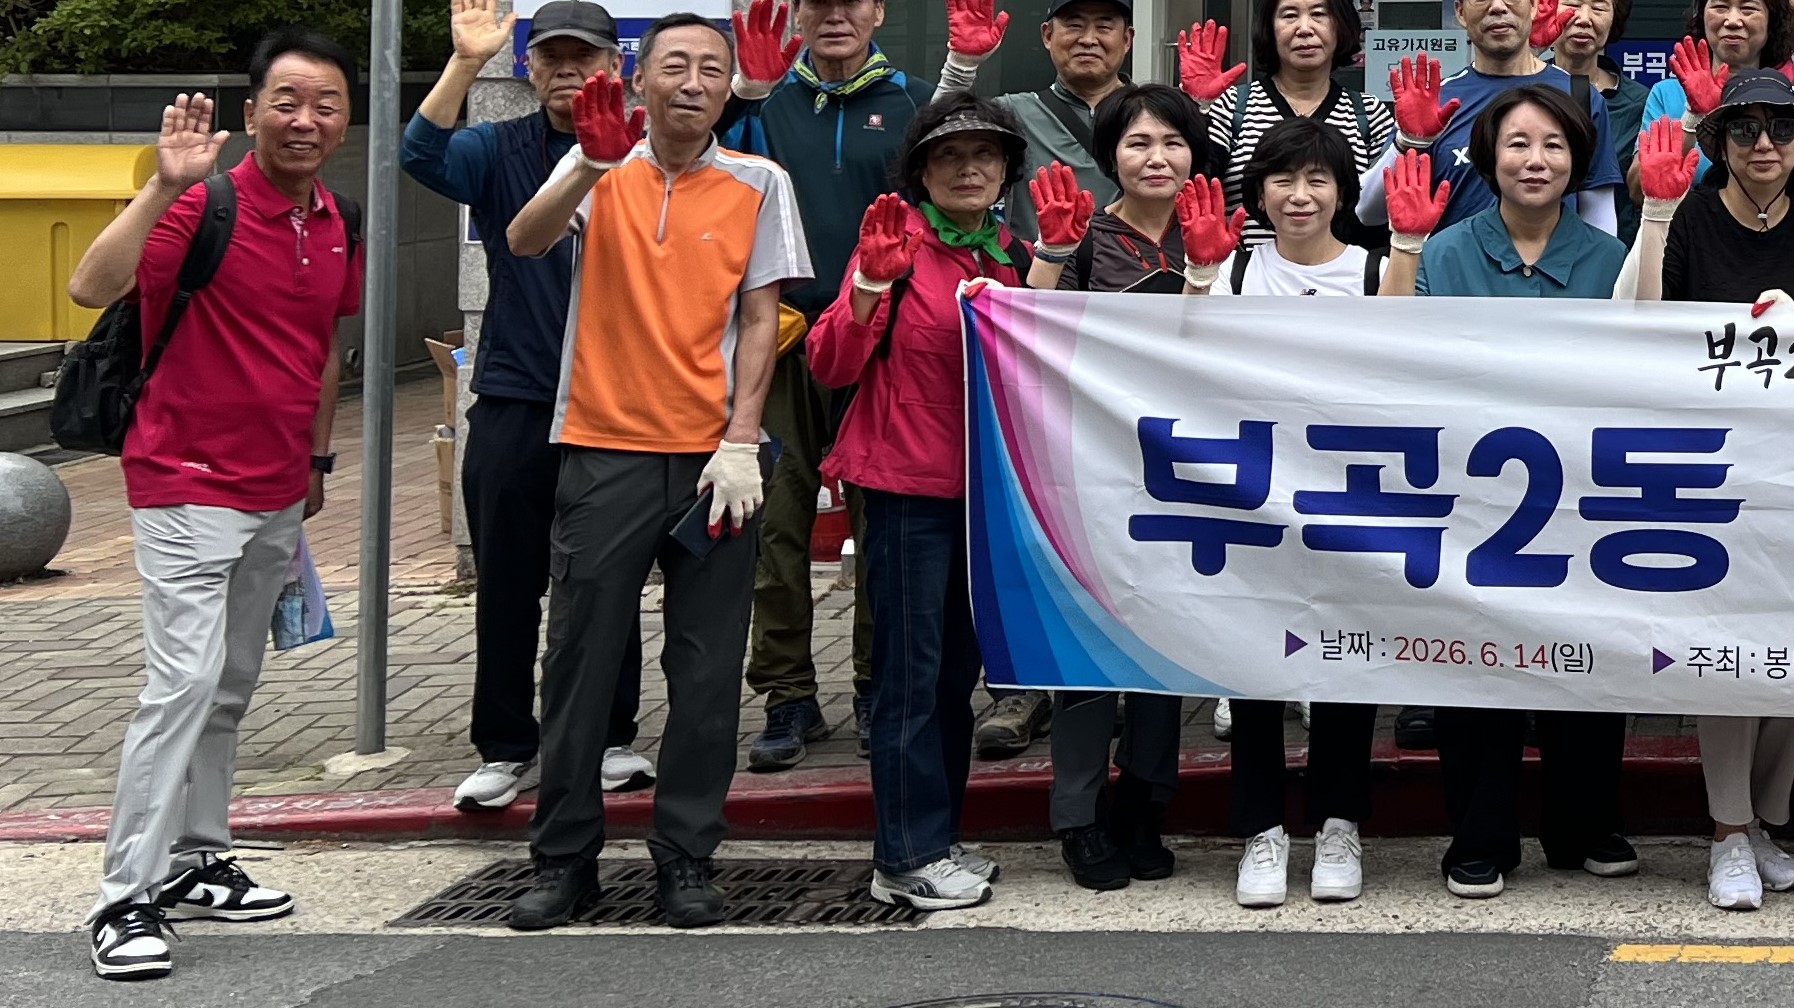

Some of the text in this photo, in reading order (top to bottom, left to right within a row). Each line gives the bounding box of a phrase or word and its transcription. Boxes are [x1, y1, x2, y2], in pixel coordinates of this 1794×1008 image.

[1372, 38, 1458, 52] 고유가지원금
[1622, 52, 1677, 80] 부곡
[1128, 416, 1747, 592] 부곡2동
[1320, 629, 1374, 662] 날짜
[1686, 645, 1741, 679] 주최
